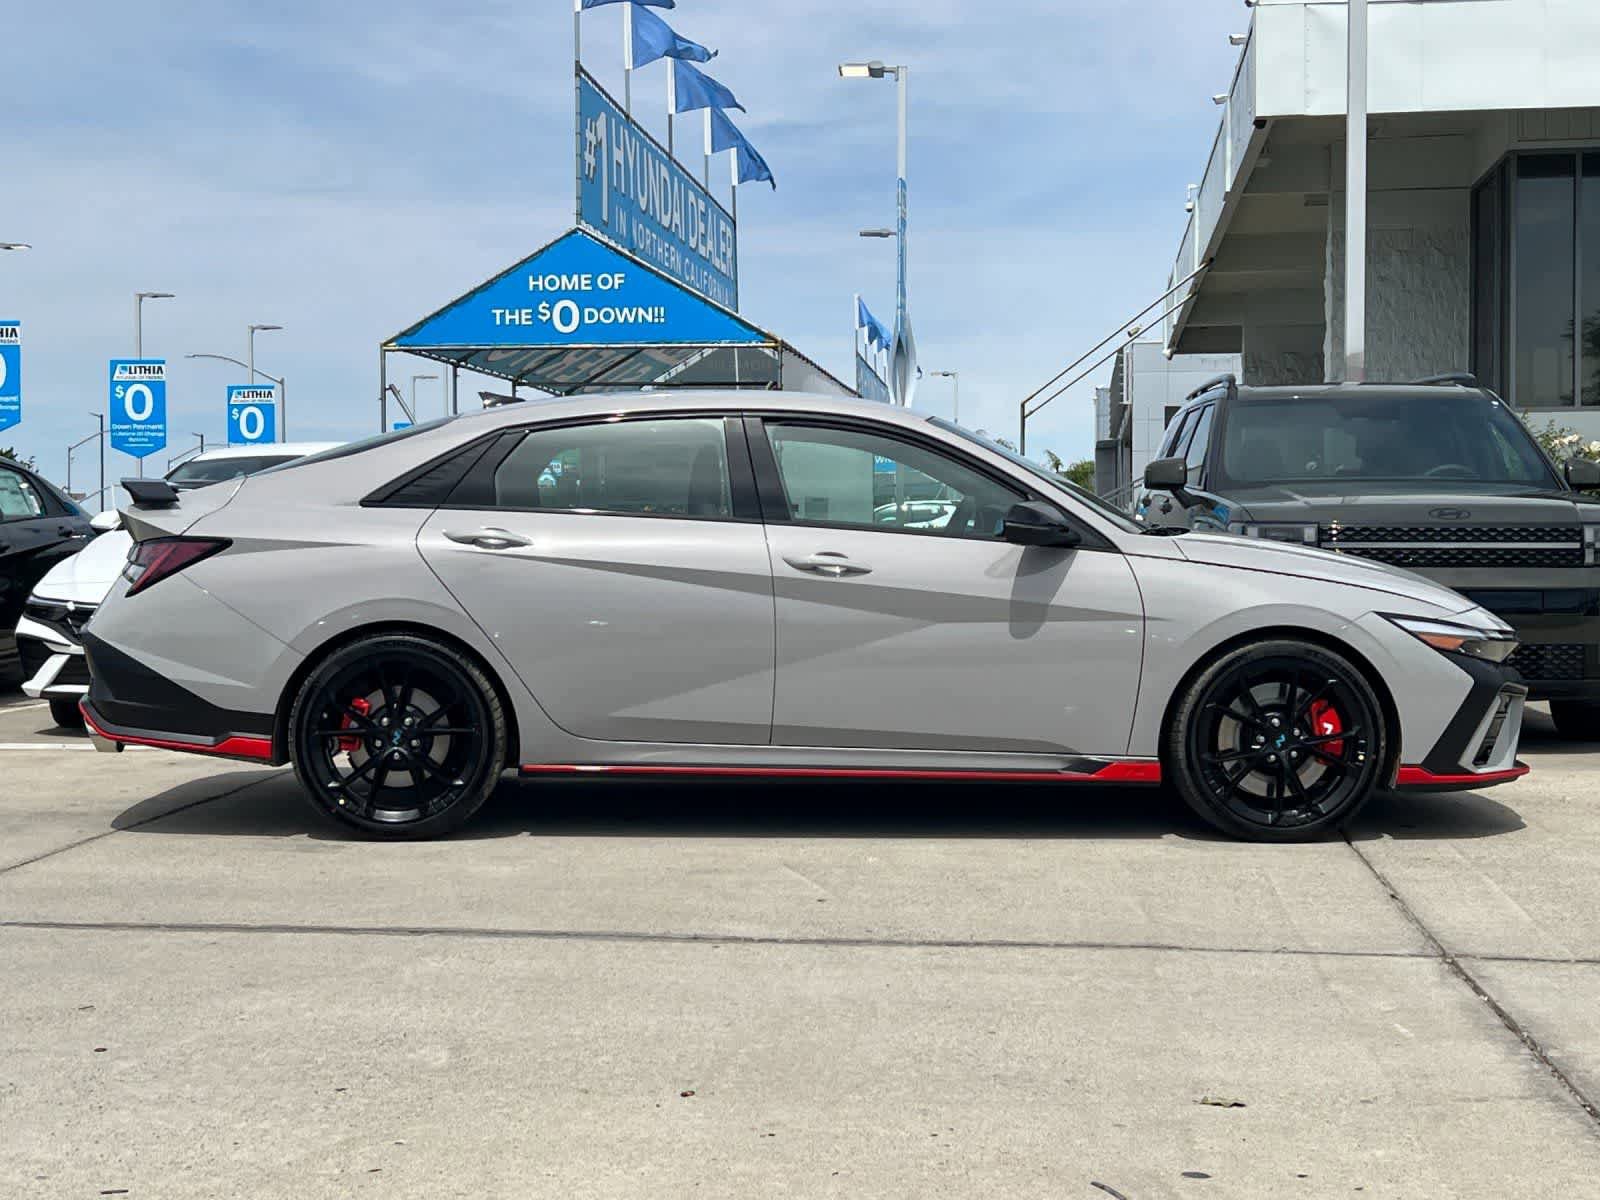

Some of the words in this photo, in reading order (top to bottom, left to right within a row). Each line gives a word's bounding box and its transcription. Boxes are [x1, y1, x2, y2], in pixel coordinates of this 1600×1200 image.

[584, 111, 609, 224] #1
[611, 117, 685, 244] HYUNDAI
[688, 189, 734, 281] DEALER
[615, 204, 627, 238] IN
[684, 257, 729, 305] CALIFORNIA
[528, 274, 592, 291] HOME
[597, 273, 625, 290] OF
[492, 309, 533, 325] THE
[584, 306, 665, 324] DOWN!!
[128, 365, 163, 375] LITHIA
[243, 390, 273, 399] LITHIA
